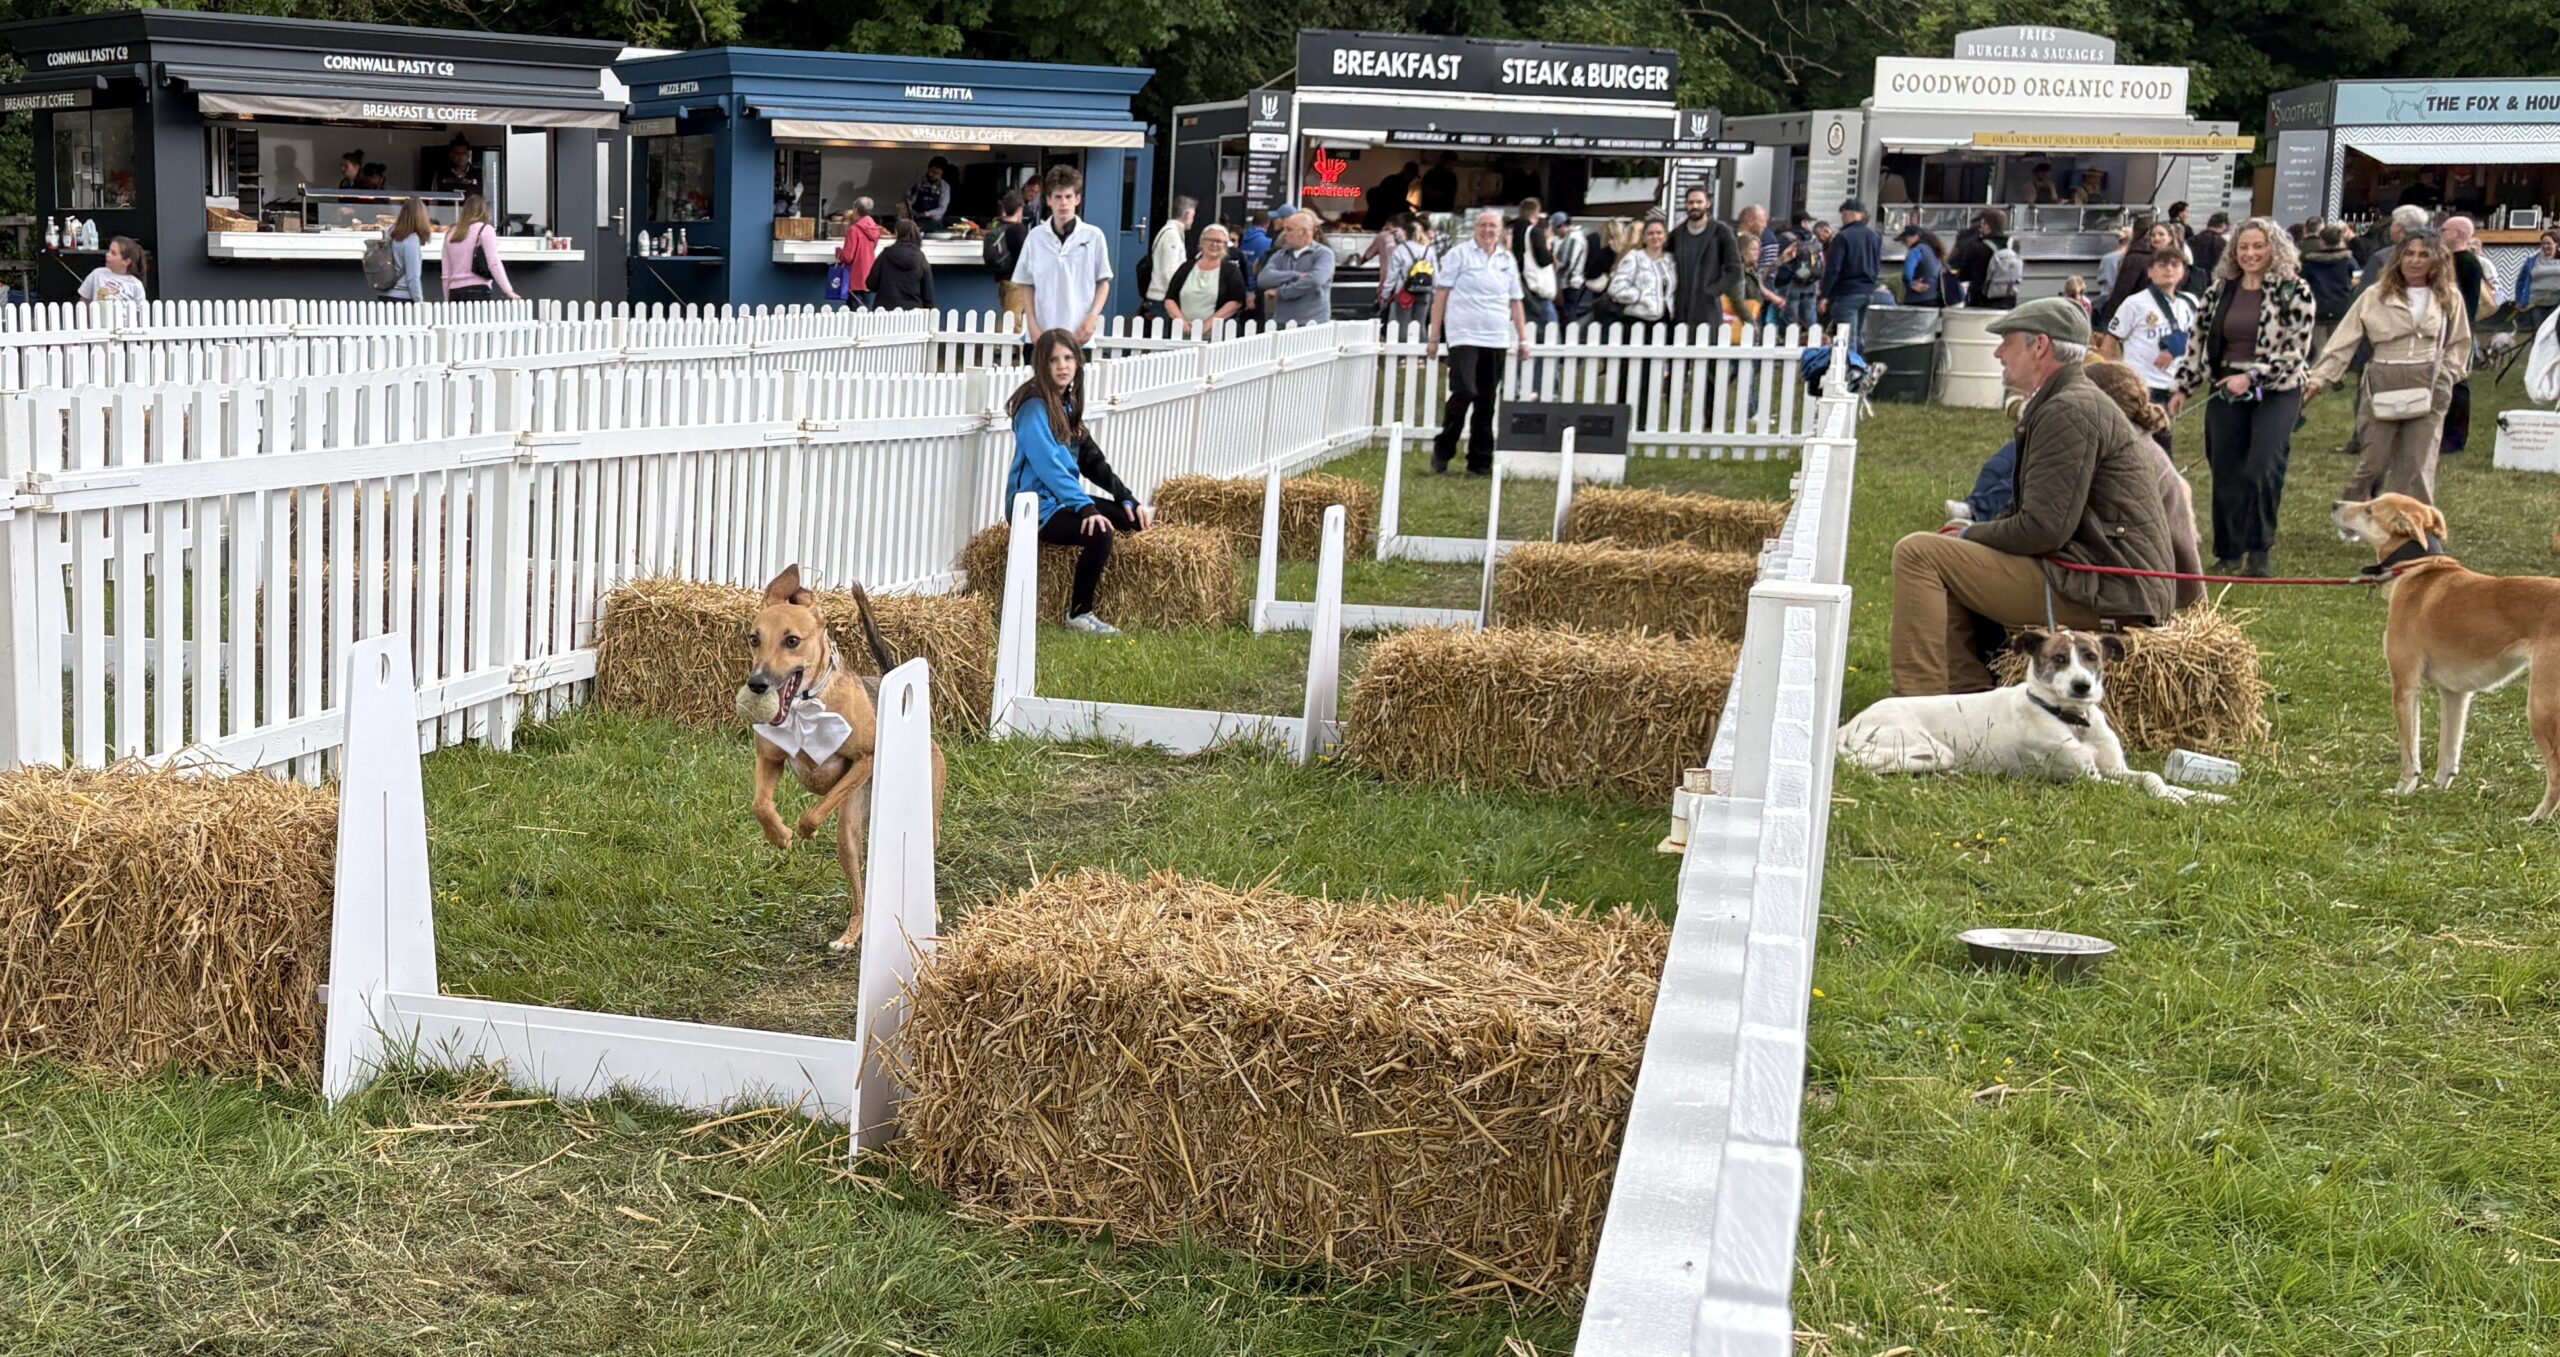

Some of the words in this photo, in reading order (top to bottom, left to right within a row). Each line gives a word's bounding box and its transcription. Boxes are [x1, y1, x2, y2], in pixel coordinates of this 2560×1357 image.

[2019, 28, 2056, 41] FRIES
[47, 50, 91, 66] CORNWALL
[91, 47, 116, 62] PASTY
[1967, 44, 2027, 58] BURGERS
[2030, 46, 2038, 59] &
[2043, 47, 2104, 61] SAUSAGES
[323, 55, 396, 72] CORNWALL
[397, 60, 435, 75] PASTY
[1333, 48, 1463, 81] BREAKFAST
[1502, 57, 1570, 86] STEAK
[1571, 65, 1586, 87] &
[1587, 62, 1670, 91] BURGER
[904, 85, 941, 99] MEZZE
[942, 87, 973, 101] PITTA
[1892, 73, 2016, 96] GOODWOOD
[2023, 77, 2114, 98] ORGANIC
[2120, 81, 2173, 100] FOOD
[4, 95, 42, 111] BREAKFAST
[48, 93, 75, 107] COFFEE
[2426, 95, 2461, 112] THE
[2465, 95, 2500, 112] FOX
[2506, 95, 2519, 111] &
[362, 103, 424, 119] BREAKFAST
[426, 107, 435, 120] &
[437, 107, 479, 121] COFFEE
[912, 128, 965, 141] BREAKFAST
